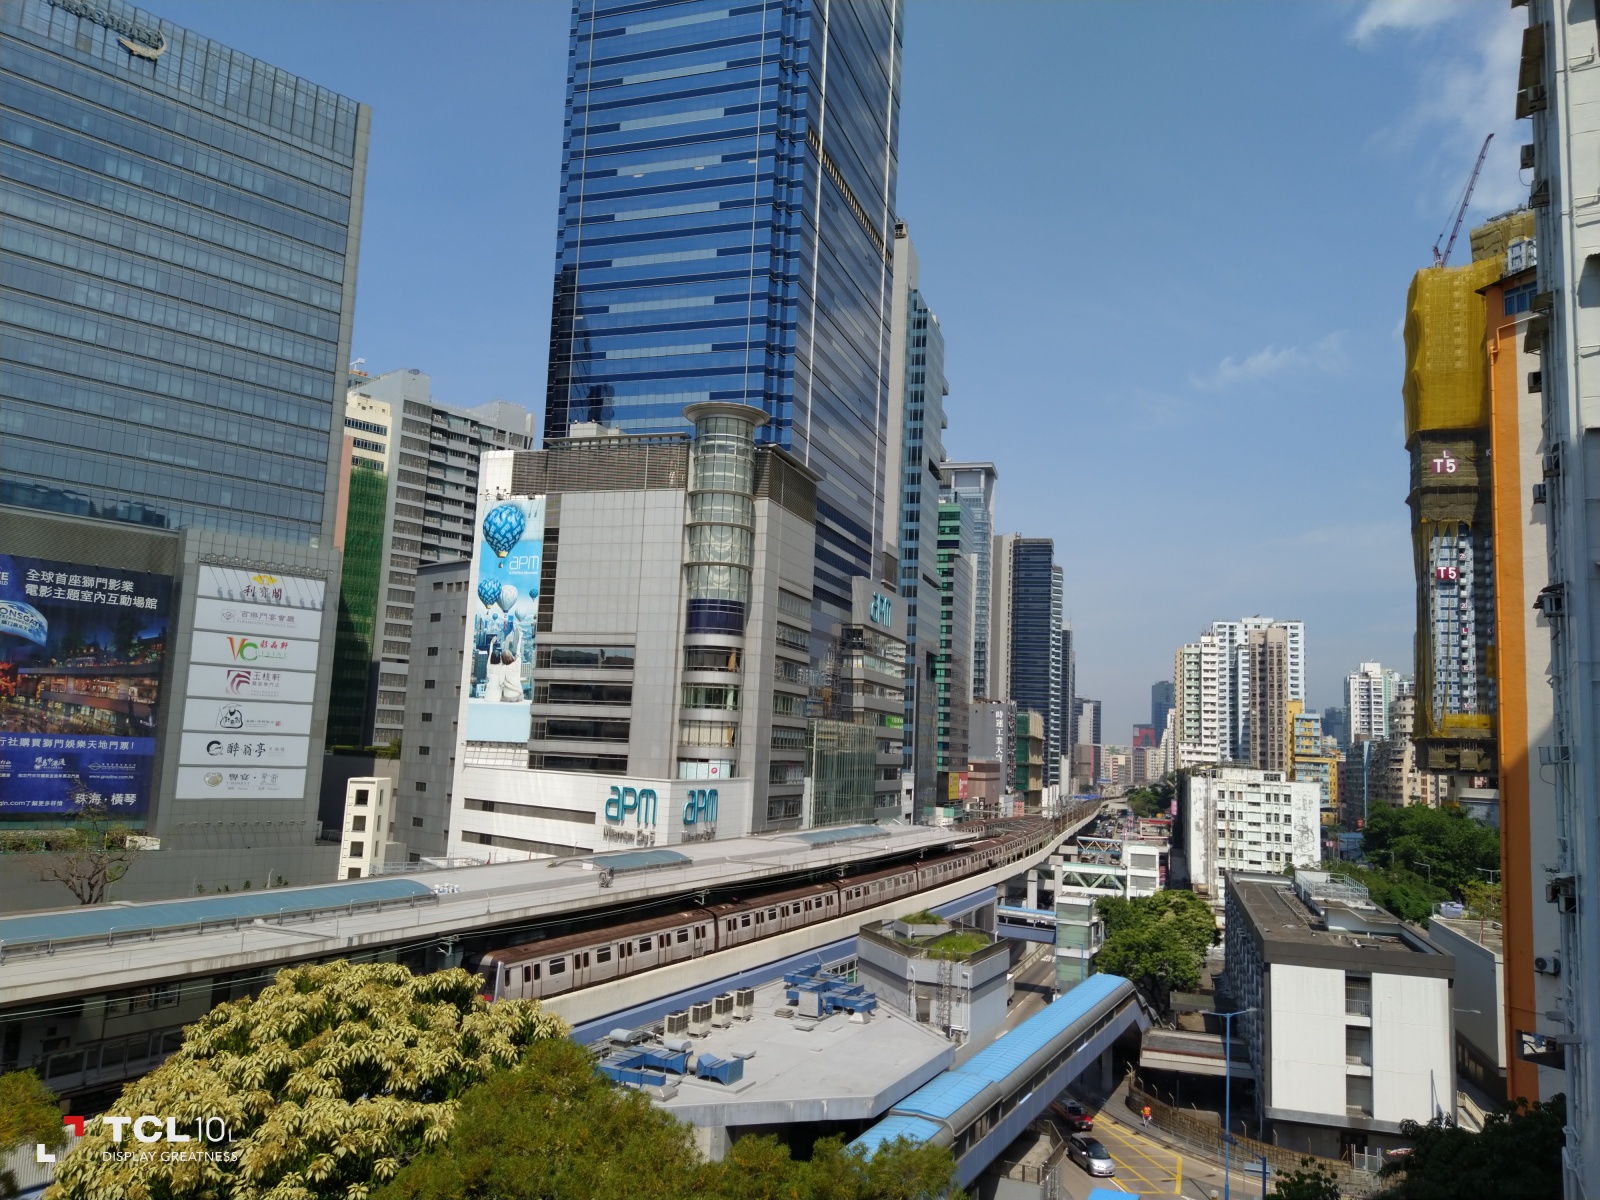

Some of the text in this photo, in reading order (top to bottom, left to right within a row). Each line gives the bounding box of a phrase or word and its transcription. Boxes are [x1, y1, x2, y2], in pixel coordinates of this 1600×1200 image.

[1443, 450, 1450, 458] L
[1433, 458, 1456, 473] T5
[1437, 566, 1457, 579] T5
[26, 568, 134, 593] 全球首座獅門影業
